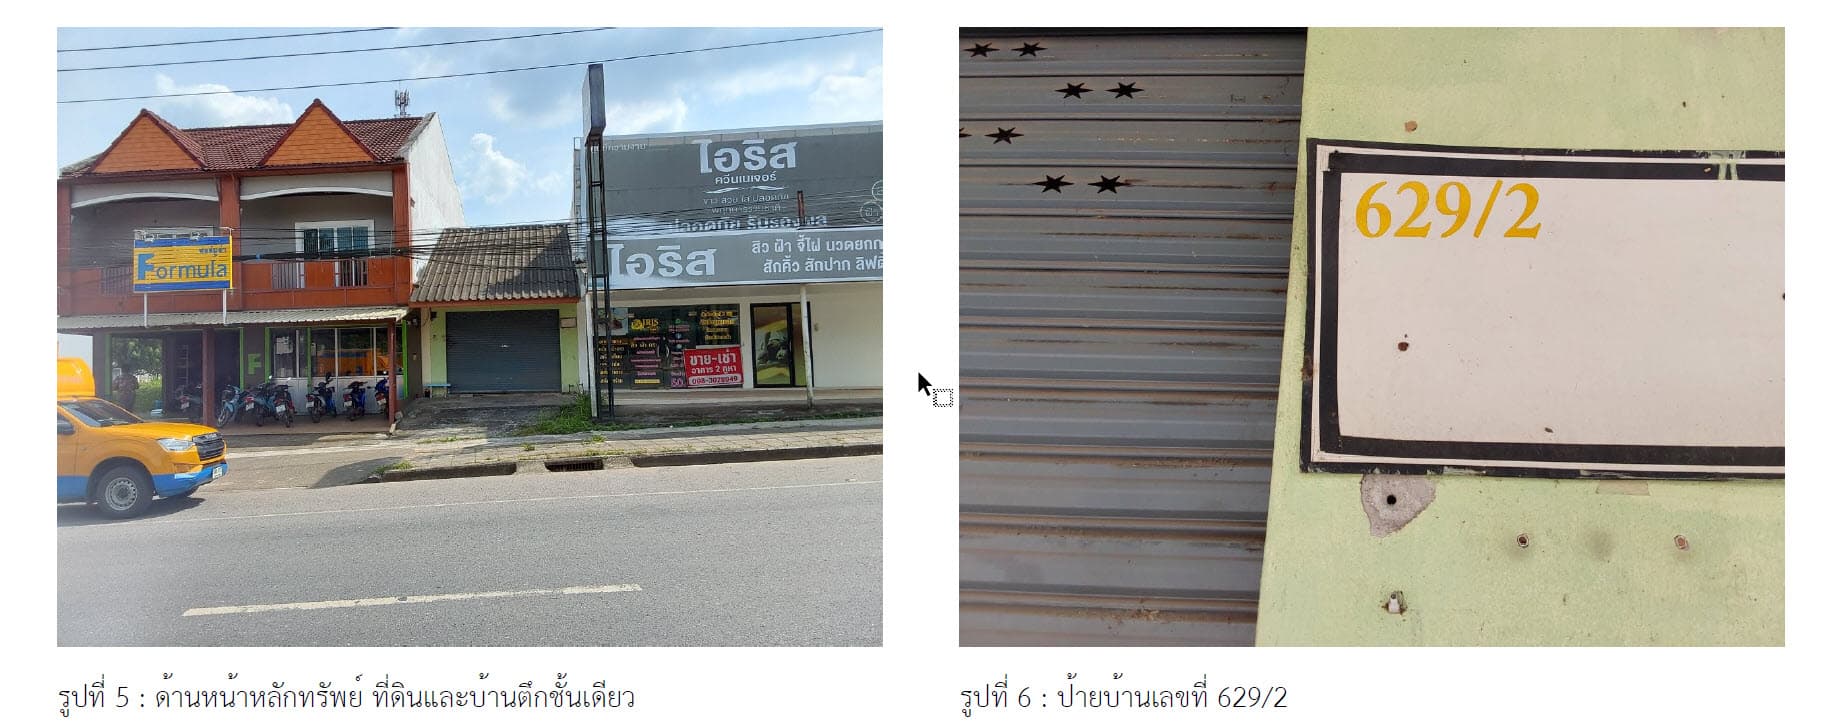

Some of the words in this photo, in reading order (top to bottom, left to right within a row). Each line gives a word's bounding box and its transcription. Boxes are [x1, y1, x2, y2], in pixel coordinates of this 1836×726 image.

[692, 138, 799, 174] ไอริส
[715, 170, 777, 185] ควีนเนเจอร์
[1355, 180, 1541, 239] 629/2
[751, 240, 770, 254] สิว
[774, 238, 792, 253] ฝ้า
[137, 252, 227, 280] Formula
[607, 243, 718, 278] ไอริส
[763, 255, 800, 274] สักคิ้ว
[804, 257, 851, 272] สักปาก
[247, 353, 262, 375] F
[690, 349, 737, 366] ขาย-เช่า
